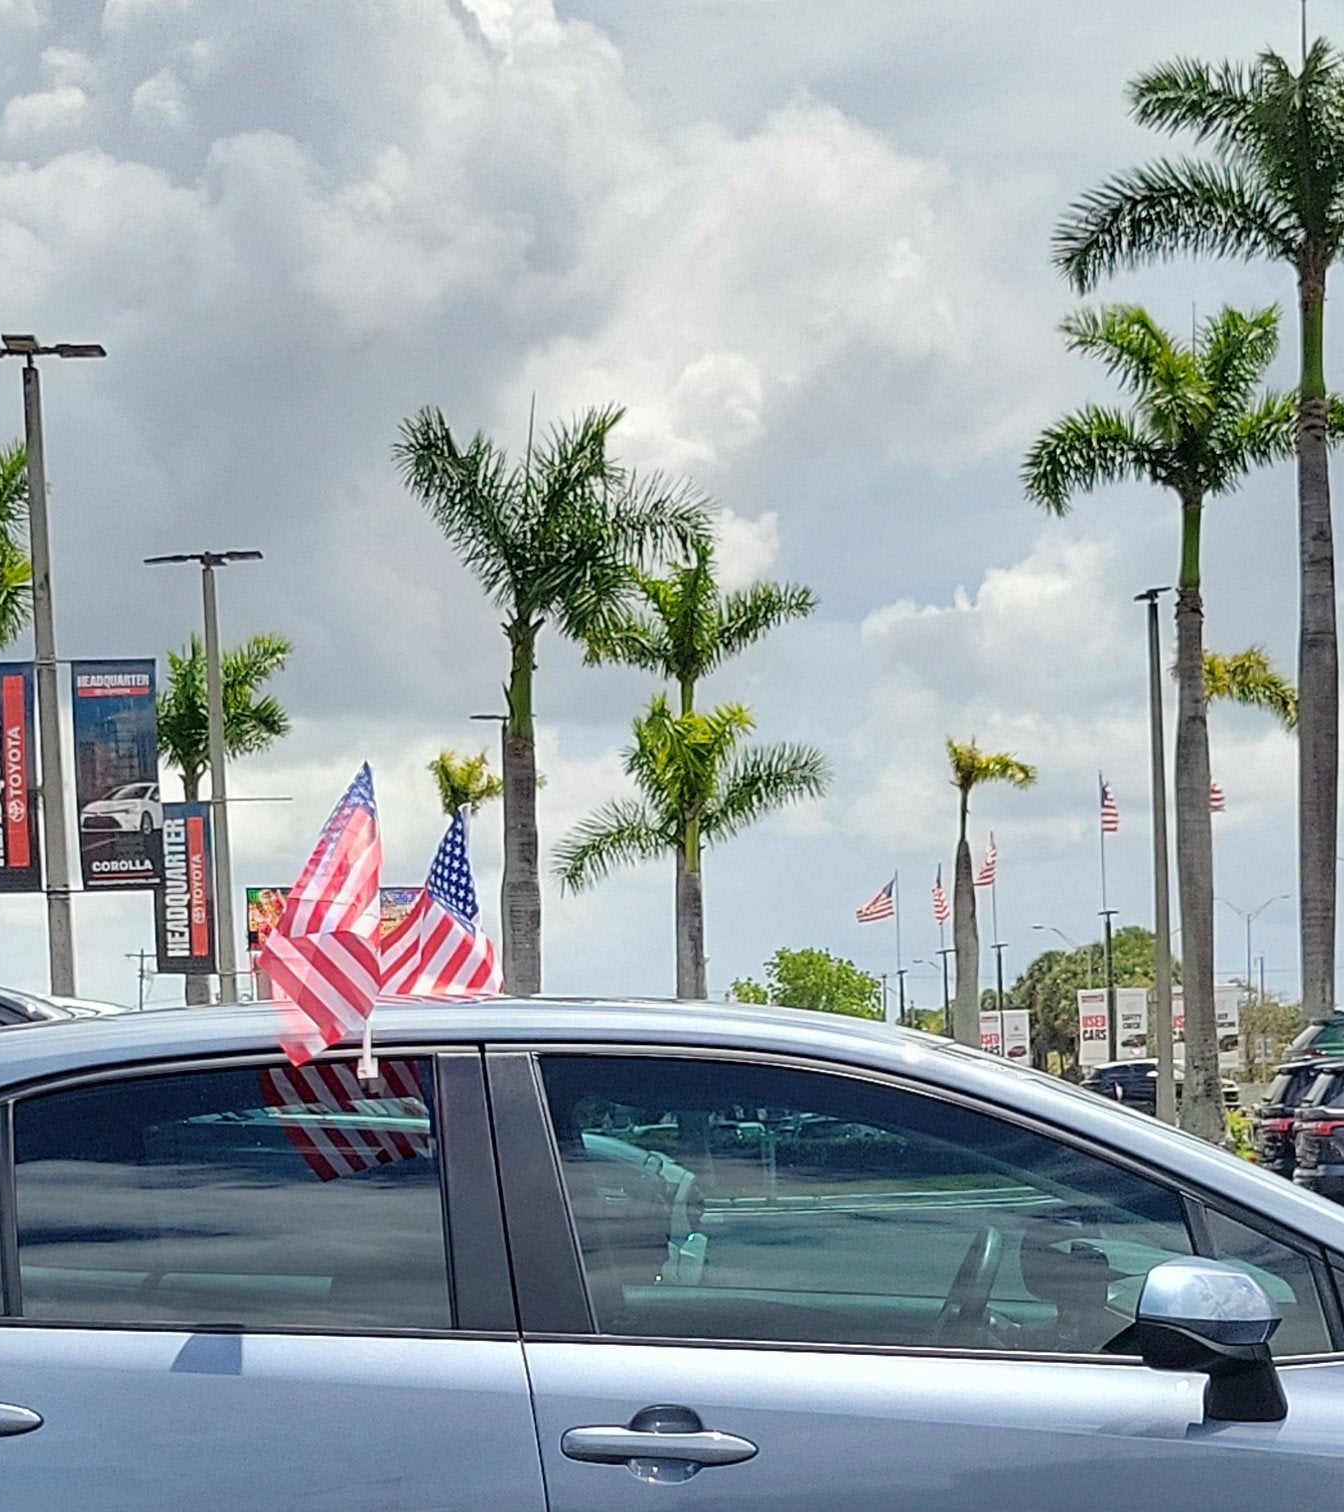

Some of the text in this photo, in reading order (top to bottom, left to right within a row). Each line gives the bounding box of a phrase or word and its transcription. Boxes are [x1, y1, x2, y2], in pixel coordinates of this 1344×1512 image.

[77, 674, 150, 689] HEADQUARTER
[8, 726, 25, 799] TOYOTA
[92, 859, 153, 872] COROLLA
[191, 853, 205, 914] TOYOTA
[163, 818, 191, 958] HEADQUARTER
[1082, 1015, 1106, 1028] USED
